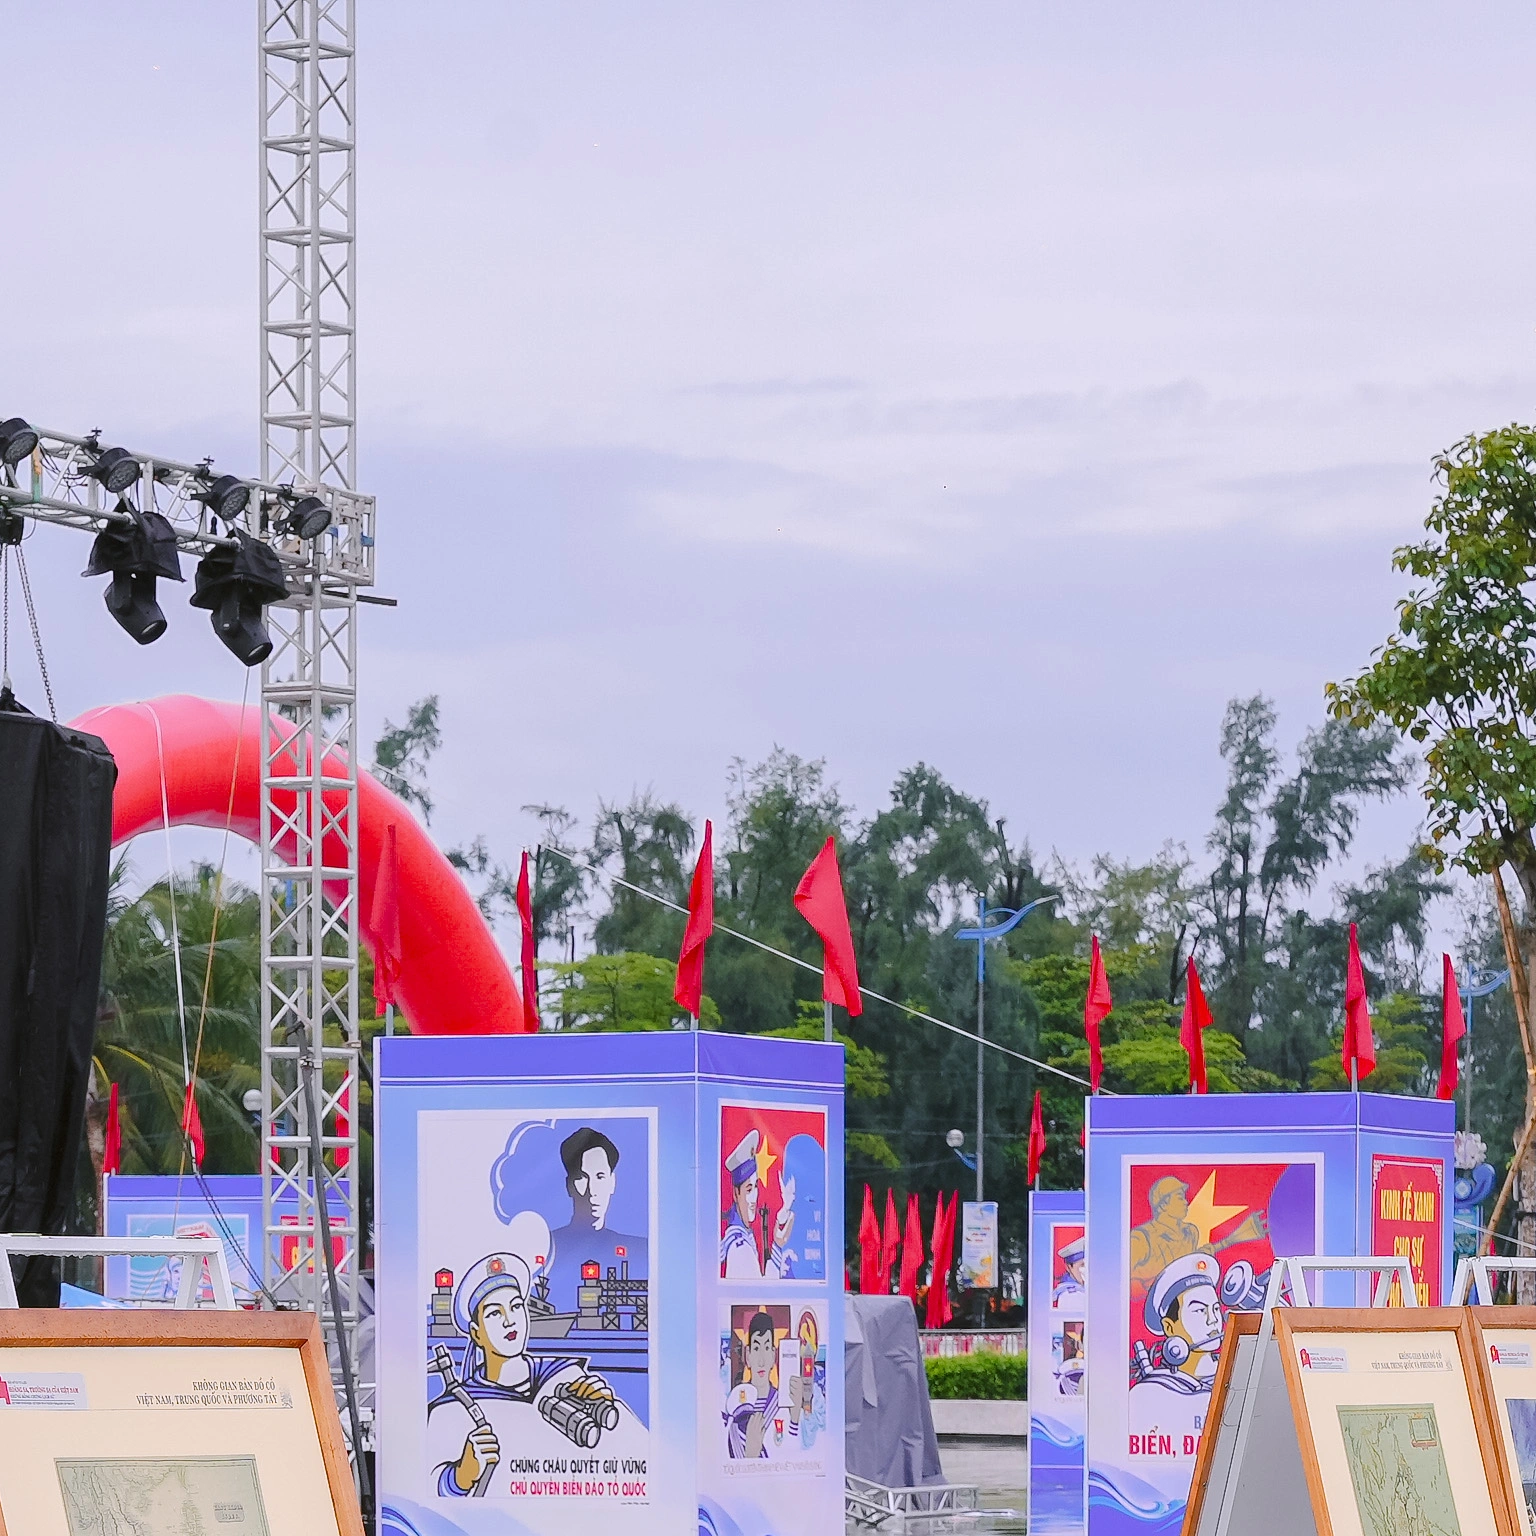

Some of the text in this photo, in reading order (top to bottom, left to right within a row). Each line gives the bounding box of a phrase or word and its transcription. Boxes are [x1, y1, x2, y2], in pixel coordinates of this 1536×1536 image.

[1381, 1181, 1435, 1222] KINH TẾ XANH
[192, 1379, 219, 1391] KHÔNG
[220, 1381, 237, 1390] GIAN
[136, 1393, 154, 1407] VIỆT
[175, 1395, 200, 1405] TRUNG
[201, 1391, 221, 1406] QUỐC
[222, 1392, 233, 1404] VÀ
[233, 1394, 263, 1404] PHƯƠNG
[1129, 1426, 1176, 1458] BIỂN,
[510, 1456, 539, 1473] CHÚNG
[543, 1457, 567, 1473] CHÁU
[570, 1454, 599, 1473] QUYẾT
[621, 1456, 647, 1474] VỮNG
[510, 1477, 527, 1495] CHỦ
[563, 1475, 582, 1495] BIỂN
[585, 1477, 604, 1496] ĐẢO
[607, 1475, 619, 1496] TỔ
[622, 1477, 646, 1496] QUỐC
